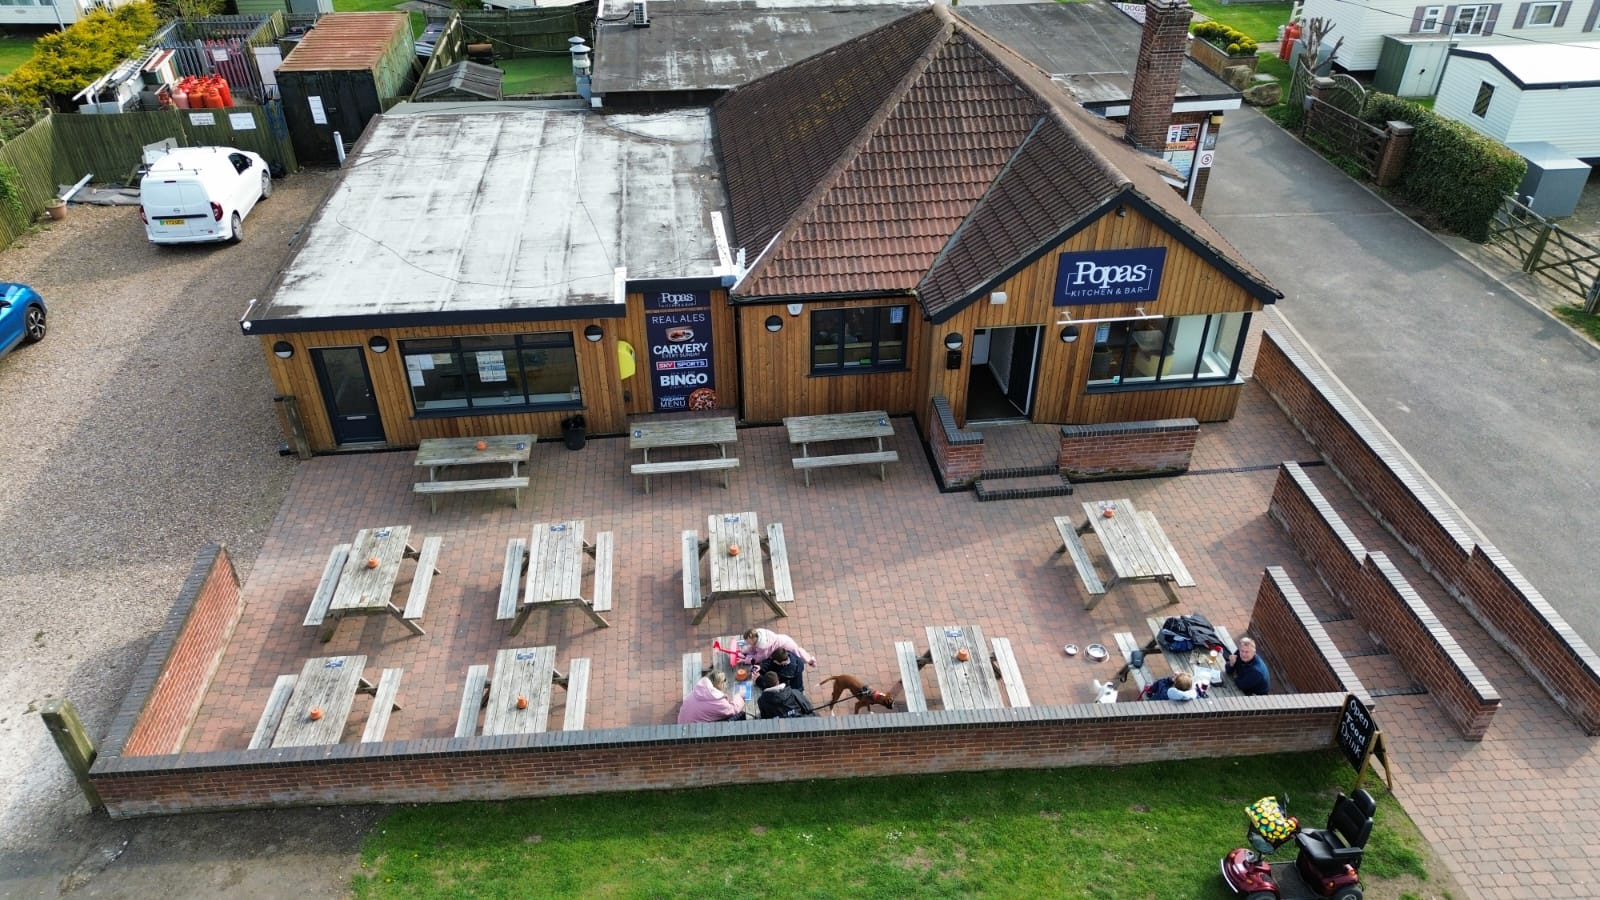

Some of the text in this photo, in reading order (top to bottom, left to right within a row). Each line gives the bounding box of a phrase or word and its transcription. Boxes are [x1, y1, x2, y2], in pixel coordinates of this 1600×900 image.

[1124, 4, 1146, 12] DOGS
[1072, 261, 1147, 289] Popas
[660, 292, 694, 305] Popas
[1070, 289, 1113, 297] KITCHEN
[1124, 287, 1143, 295] BAR
[651, 313, 705, 324] REAL ALES
[653, 342, 708, 355] CARVERY
[660, 373, 708, 387] BINGO
[660, 400, 686, 408] MENU
[1350, 700, 1369, 729] Open
[1345, 711, 1366, 745] Food
[1341, 721, 1361, 758] Drink
